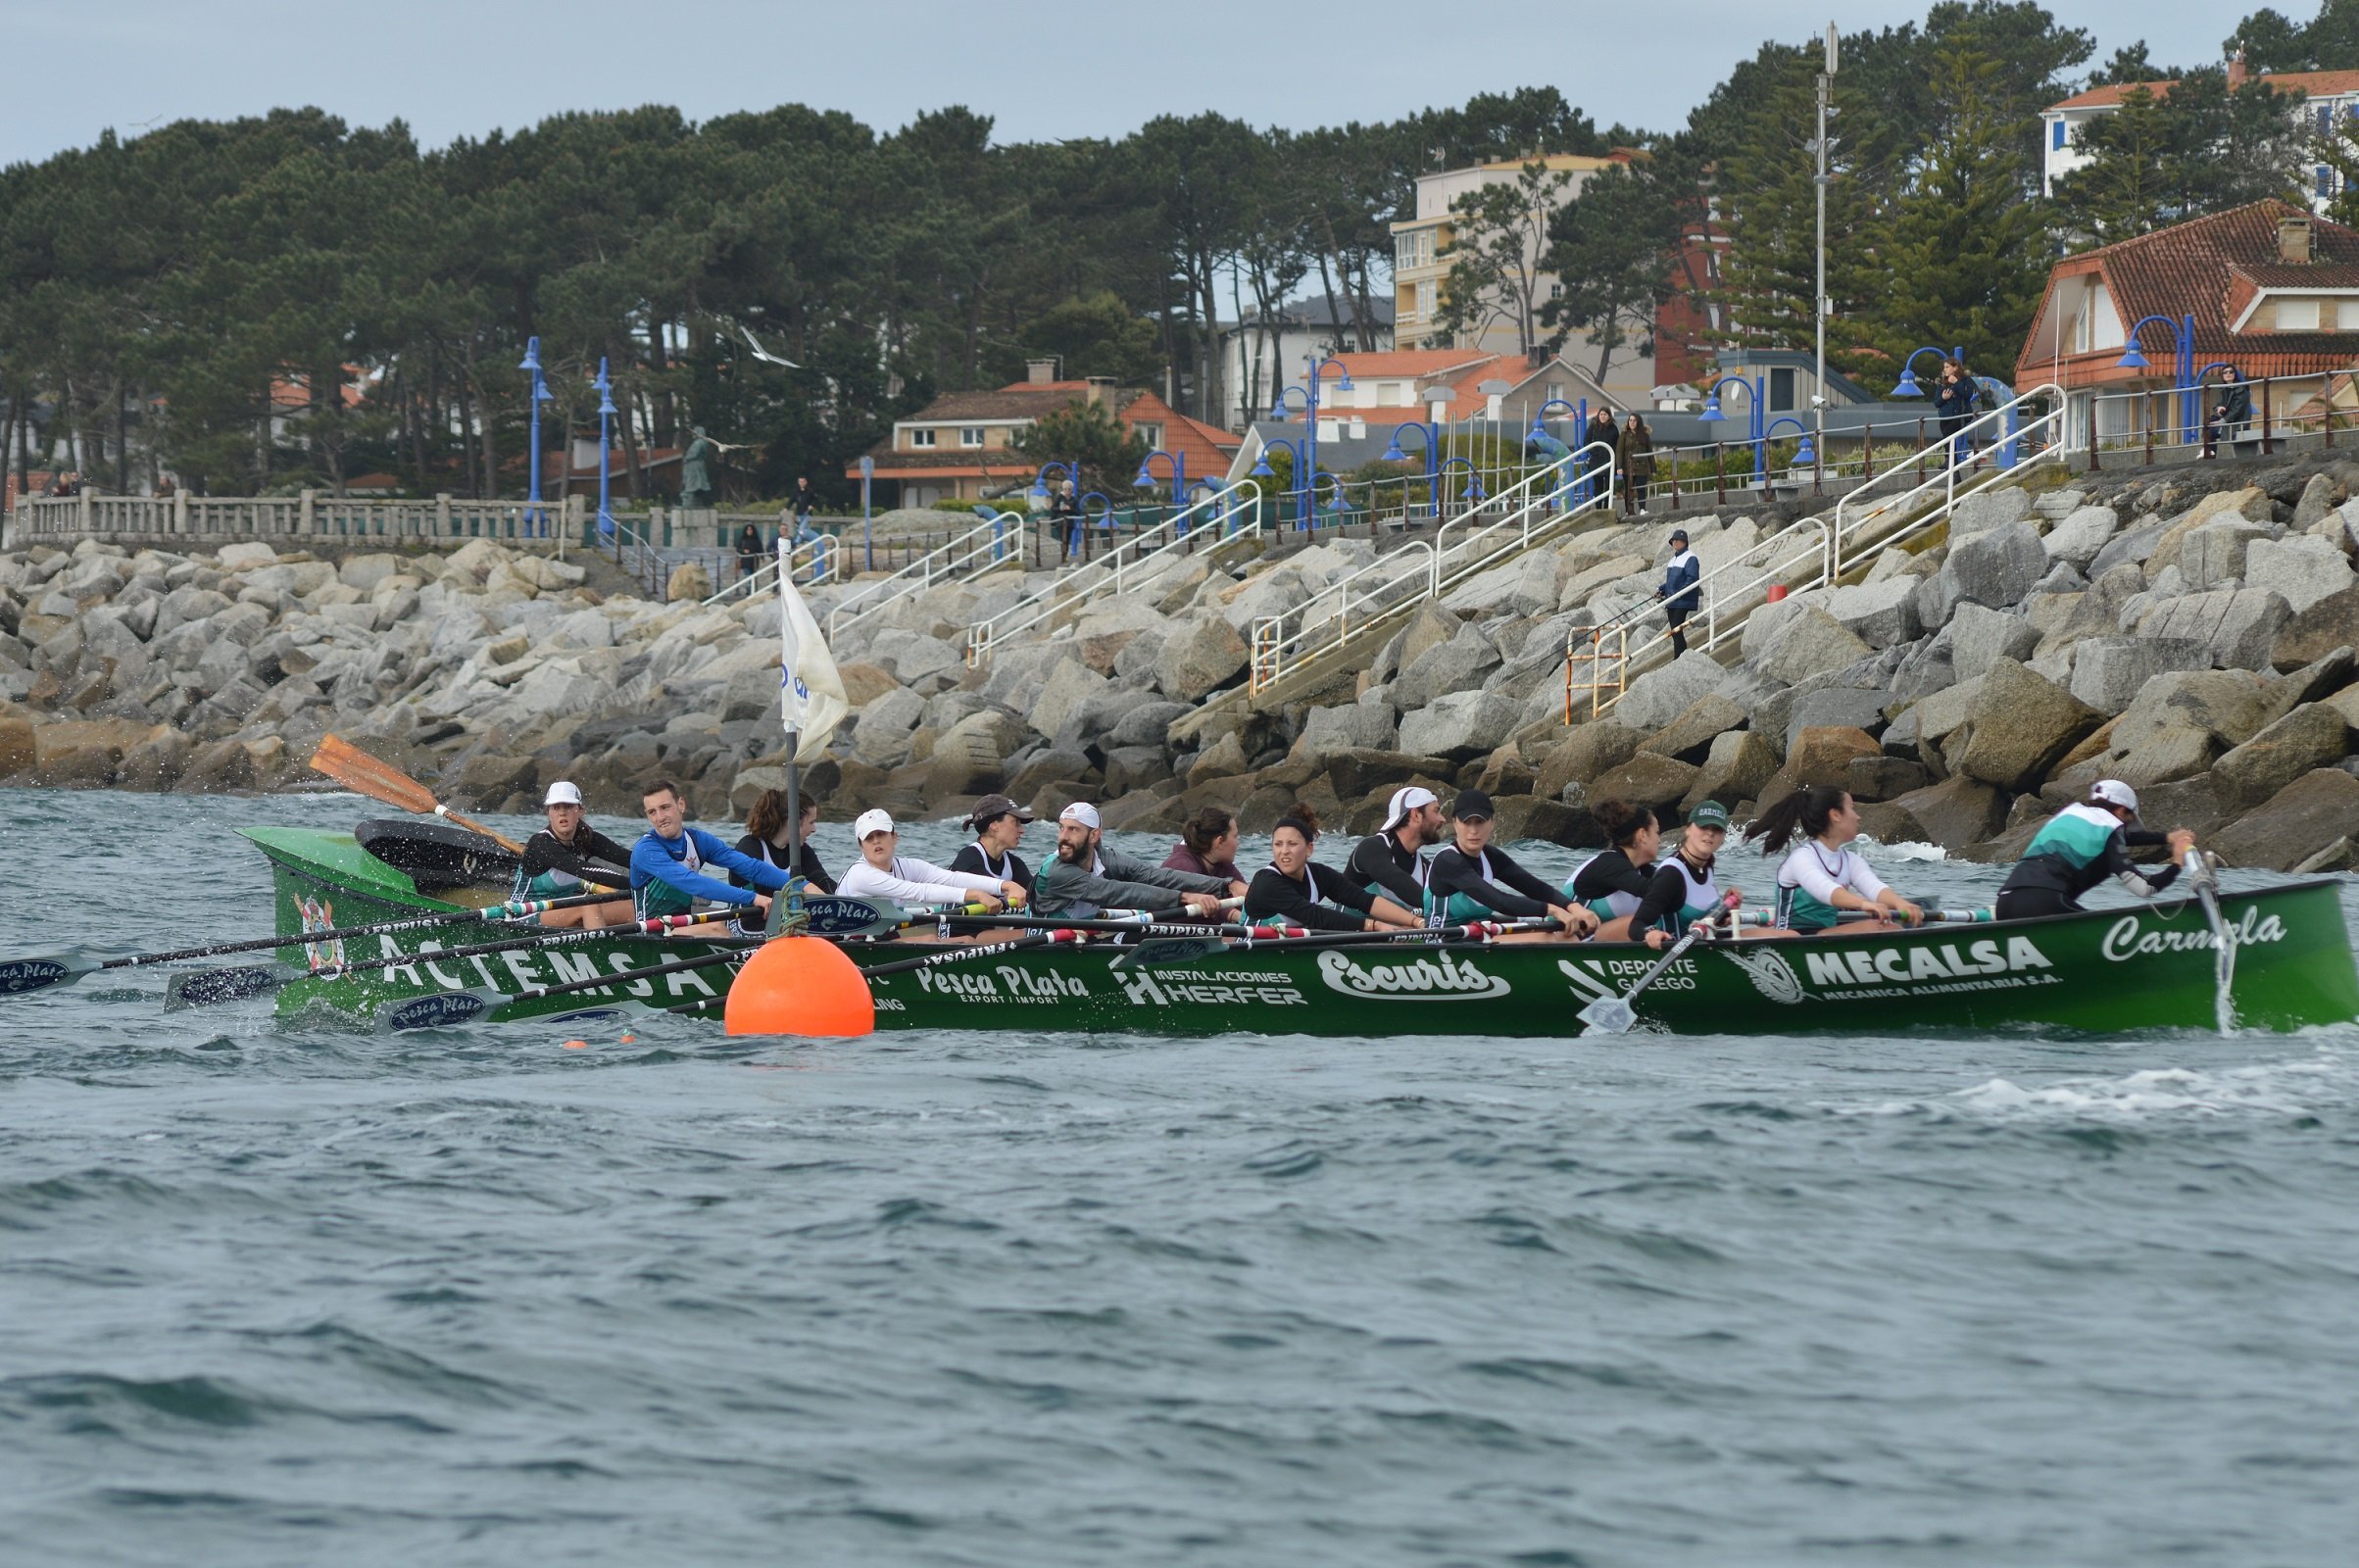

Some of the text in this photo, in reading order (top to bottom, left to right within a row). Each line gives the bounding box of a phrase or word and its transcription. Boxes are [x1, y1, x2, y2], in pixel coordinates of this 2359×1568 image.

[837, 901, 876, 921] Plata
[542, 930, 607, 946] FRIPUSA
[1149, 924, 1216, 937] FRIPUSA
[930, 943, 1007, 964] FRIPUSA
[1804, 935, 2054, 986] MECALSA
[378, 934, 717, 997] ACTEMSA
[1317, 949, 1511, 1001] Escuris
[915, 966, 998, 996] Pesca
[995, 965, 1090, 997] Plata
[1153, 969, 1293, 984] INSTALACIONES
[1823, 973, 2064, 1001] MECANICA ALIMENTARIA S.A.
[873, 998, 907, 1010] LING
[959, 994, 1005, 1004] EXPORT
[1015, 996, 1059, 1004] IMPORT
[1162, 984, 1308, 1005] HERFER
[395, 996, 481, 1026] Pesca Plata
